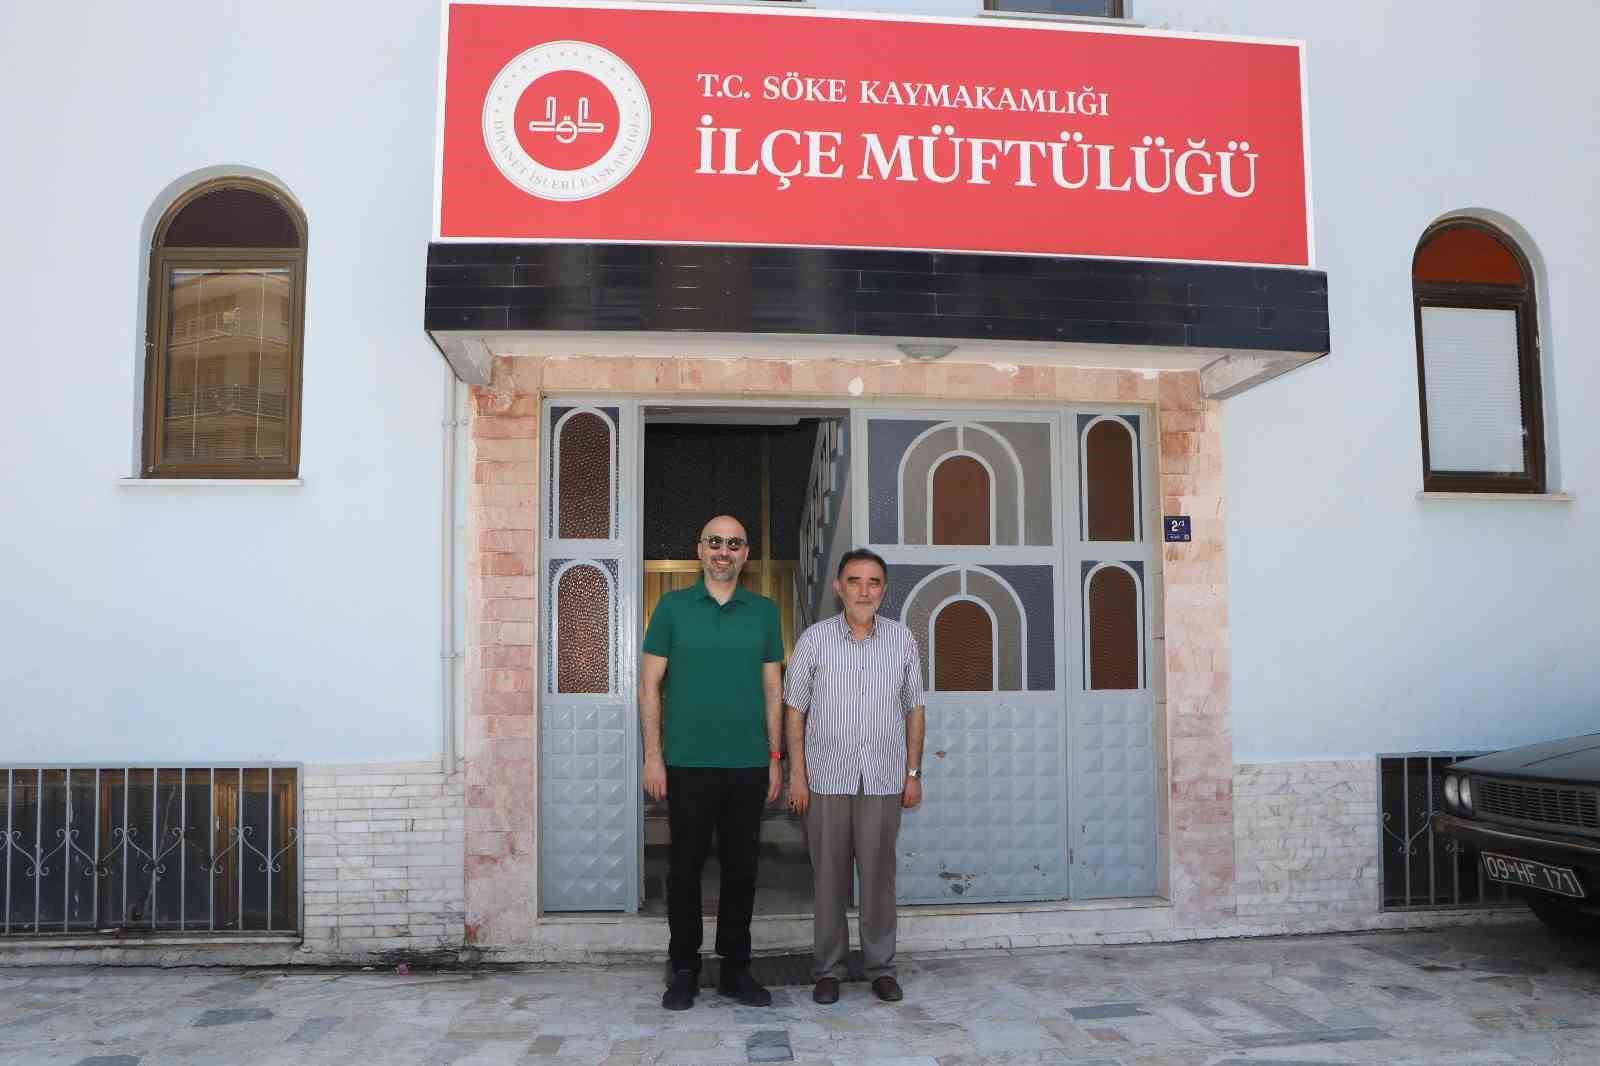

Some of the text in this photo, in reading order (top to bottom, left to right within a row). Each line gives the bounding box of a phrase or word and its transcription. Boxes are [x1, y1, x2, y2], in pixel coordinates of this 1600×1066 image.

[697, 70, 1109, 117] T.C. SÖKE KAYMAKAMLIĞI
[696, 113, 1259, 199] İLÇE MÜFTÜLÜĞÜ
[1486, 856, 1577, 893] 09 HF 171
